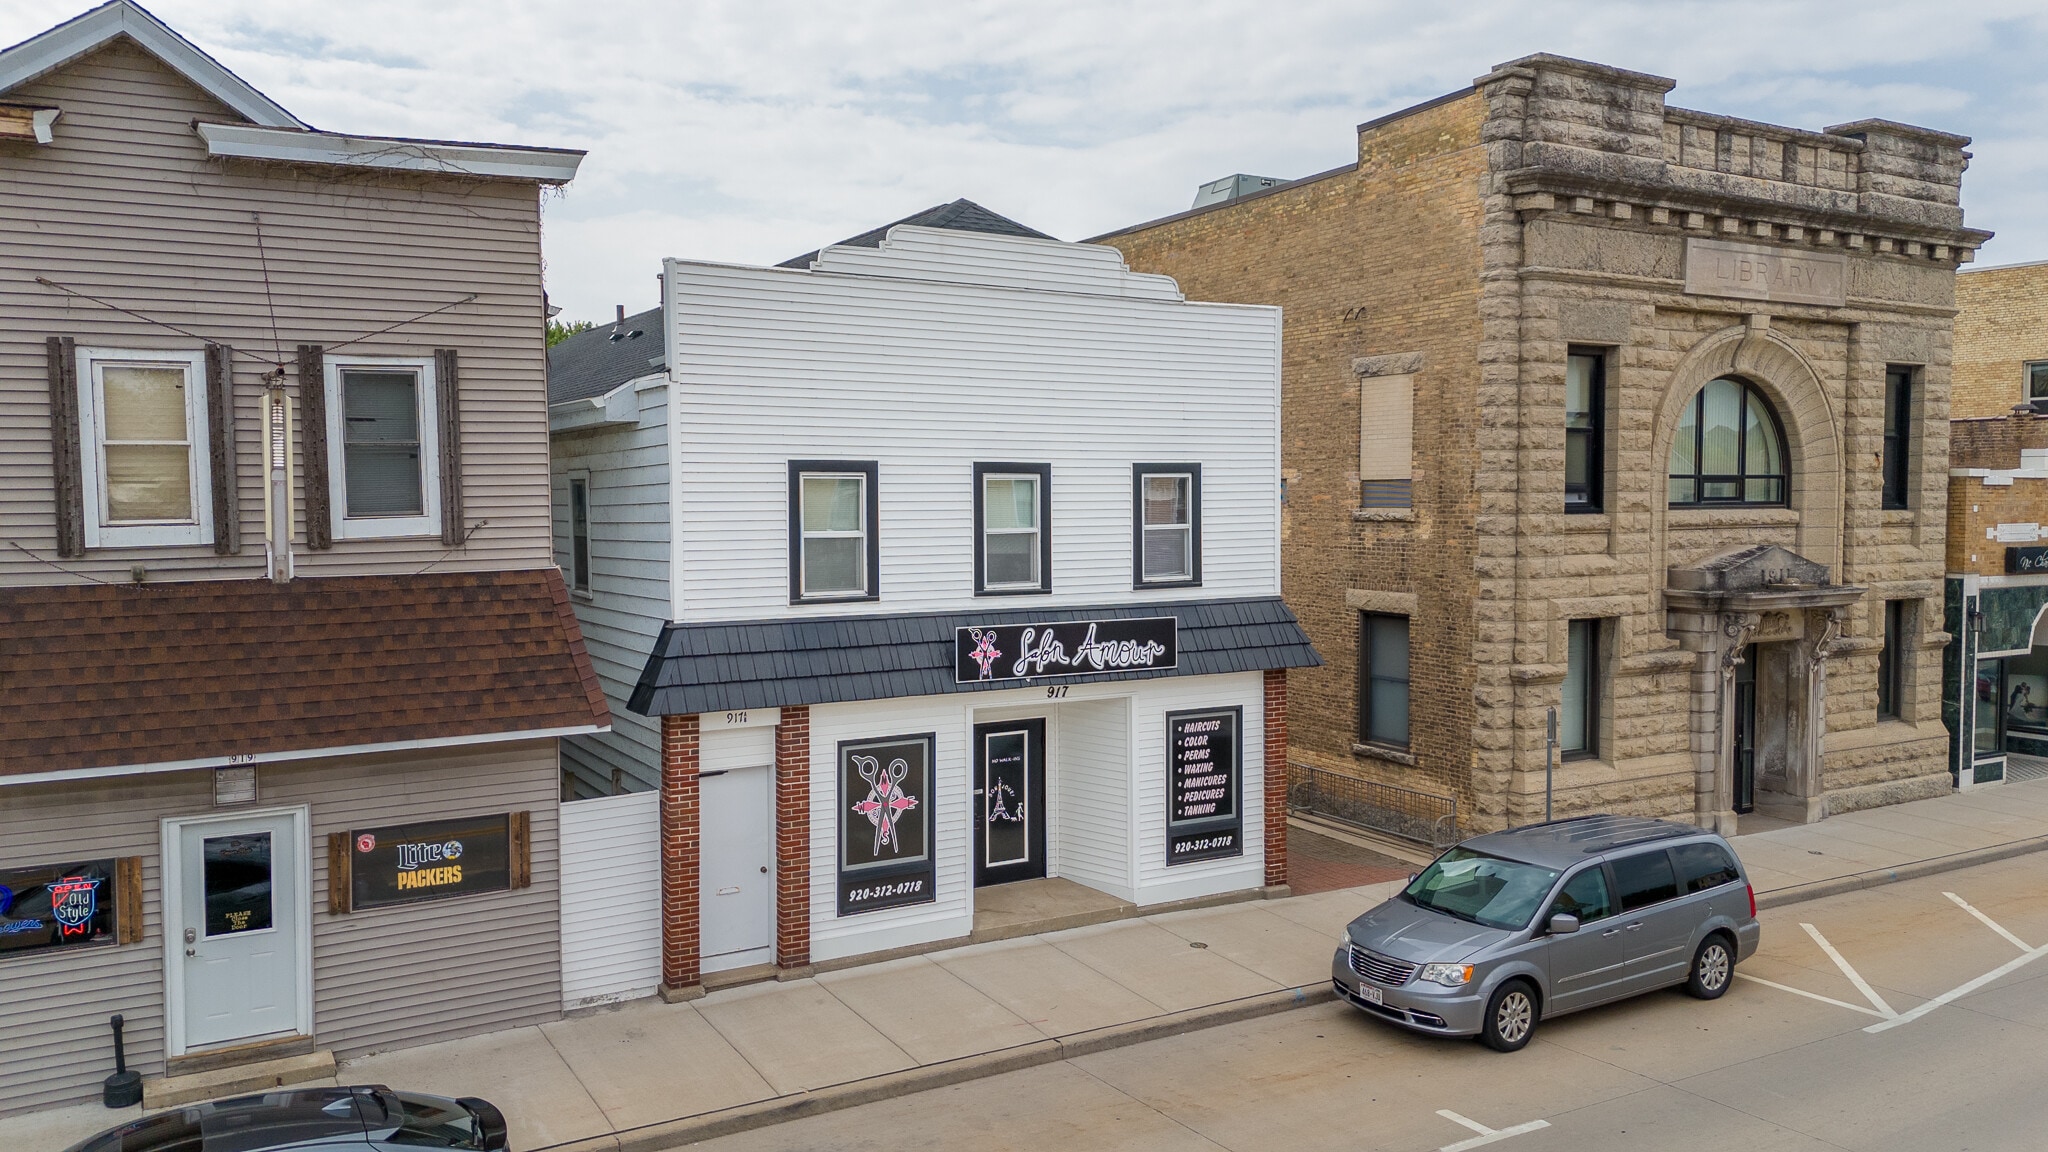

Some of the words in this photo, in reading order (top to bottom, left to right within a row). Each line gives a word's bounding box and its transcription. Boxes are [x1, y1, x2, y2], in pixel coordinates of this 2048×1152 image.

[1716, 257, 1817, 288] LIBRARY
[1072, 623, 1165, 669] Amour
[1047, 686, 1069, 699] 917
[1184, 720, 1221, 734] HAIRCUTS
[1184, 735, 1208, 748] COLOR
[231, 754, 254, 763] 919
[1184, 749, 1211, 762] PERMS
[1184, 762, 1214, 775] WAXING
[1184, 774, 1227, 789] MANICURES
[1184, 788, 1225, 803] PEDICURES
[1184, 803, 1216, 817] TANNING
[1175, 836, 1233, 854] 920-312-0718
[397, 842, 442, 870] Lite
[397, 864, 463, 890] PACKERS
[54, 883, 93, 892] OPEN
[849, 880, 923, 902] 920-312-0718
[69, 893, 90, 906] Old
[59, 906, 89, 922] Style
[225, 910, 252, 919] PLEASE
